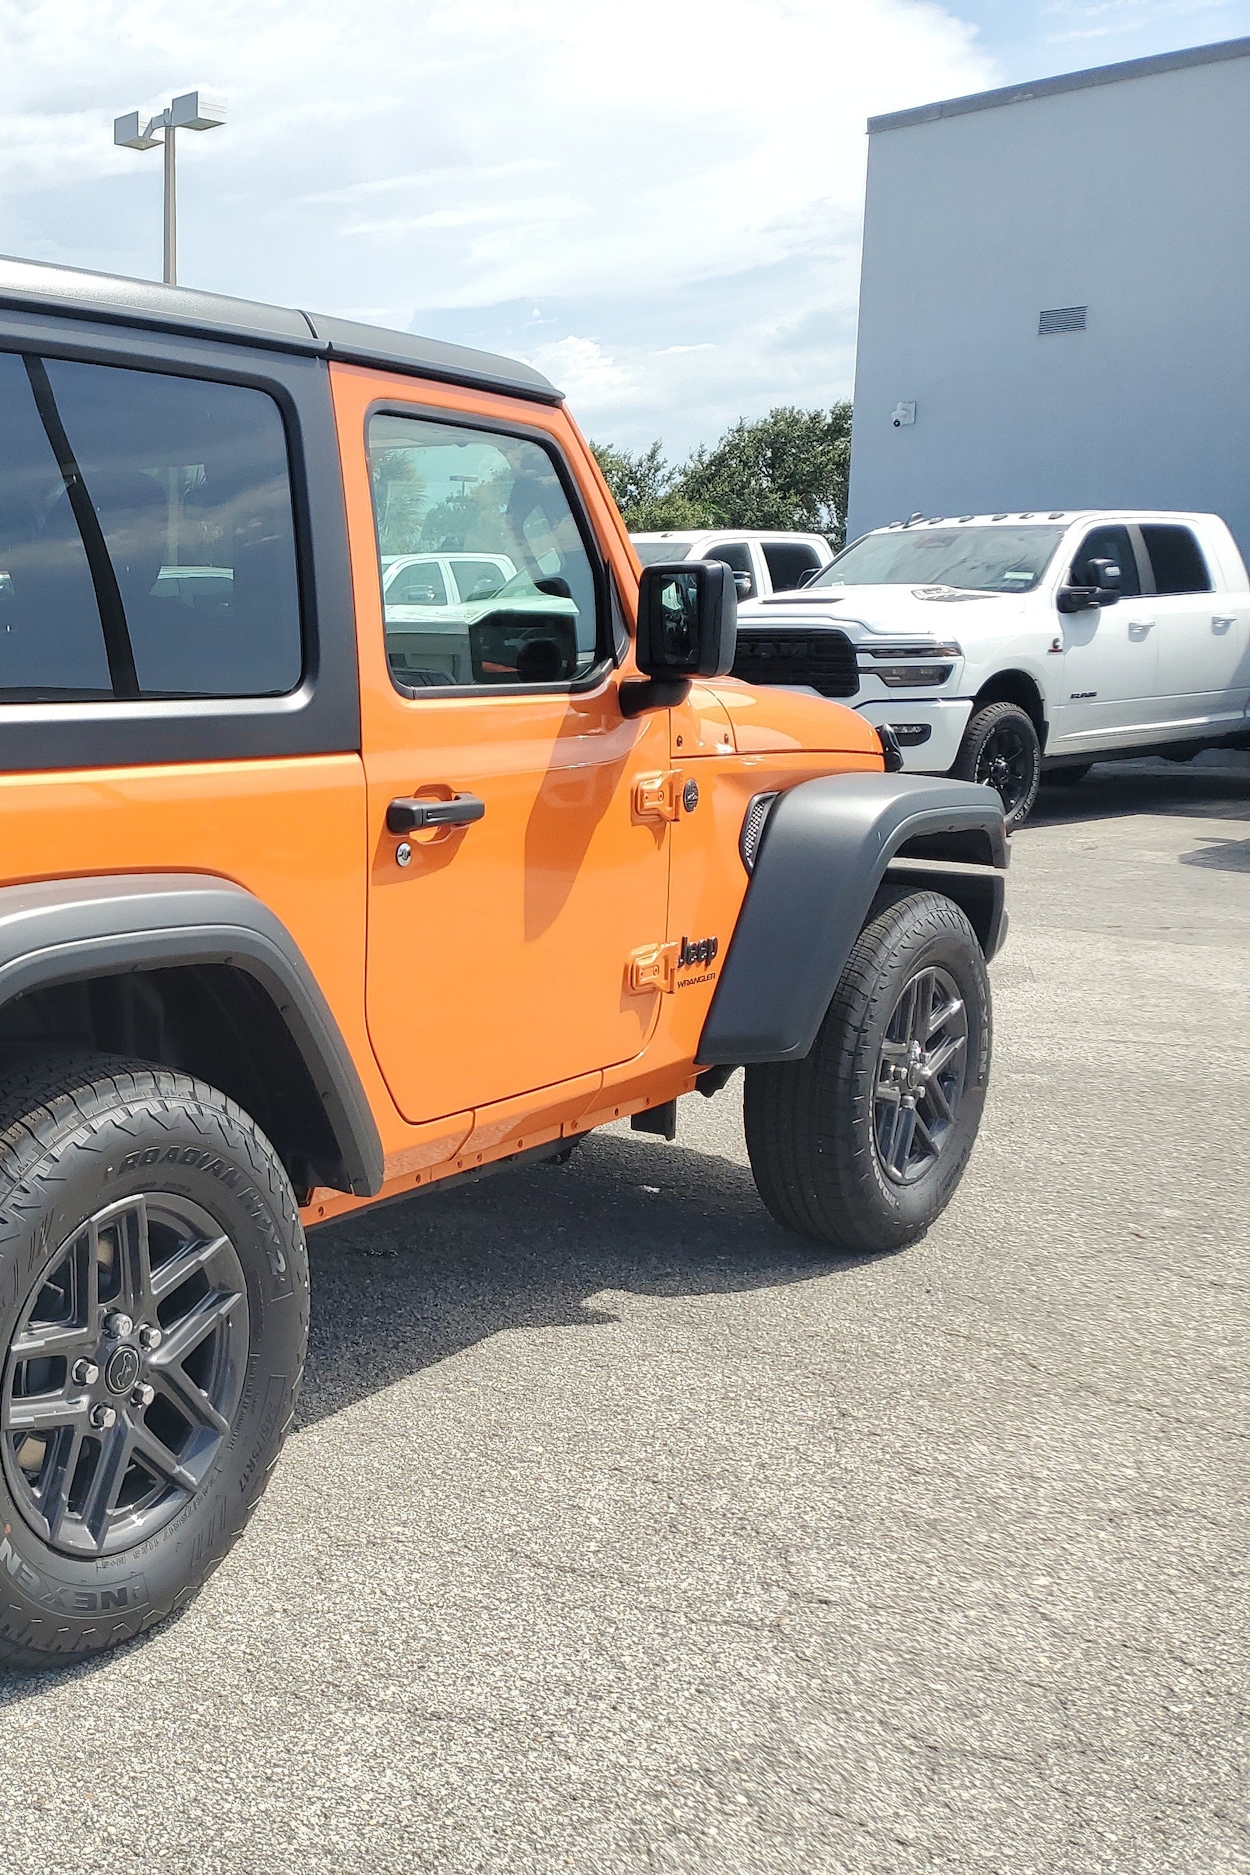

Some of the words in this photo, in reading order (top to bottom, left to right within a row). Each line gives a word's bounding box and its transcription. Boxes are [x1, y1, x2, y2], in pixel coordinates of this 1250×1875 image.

[677, 935, 718, 968] Jeep
[677, 972, 716, 988] WRANGLER
[117, 1145, 243, 1189] ROADIAN
